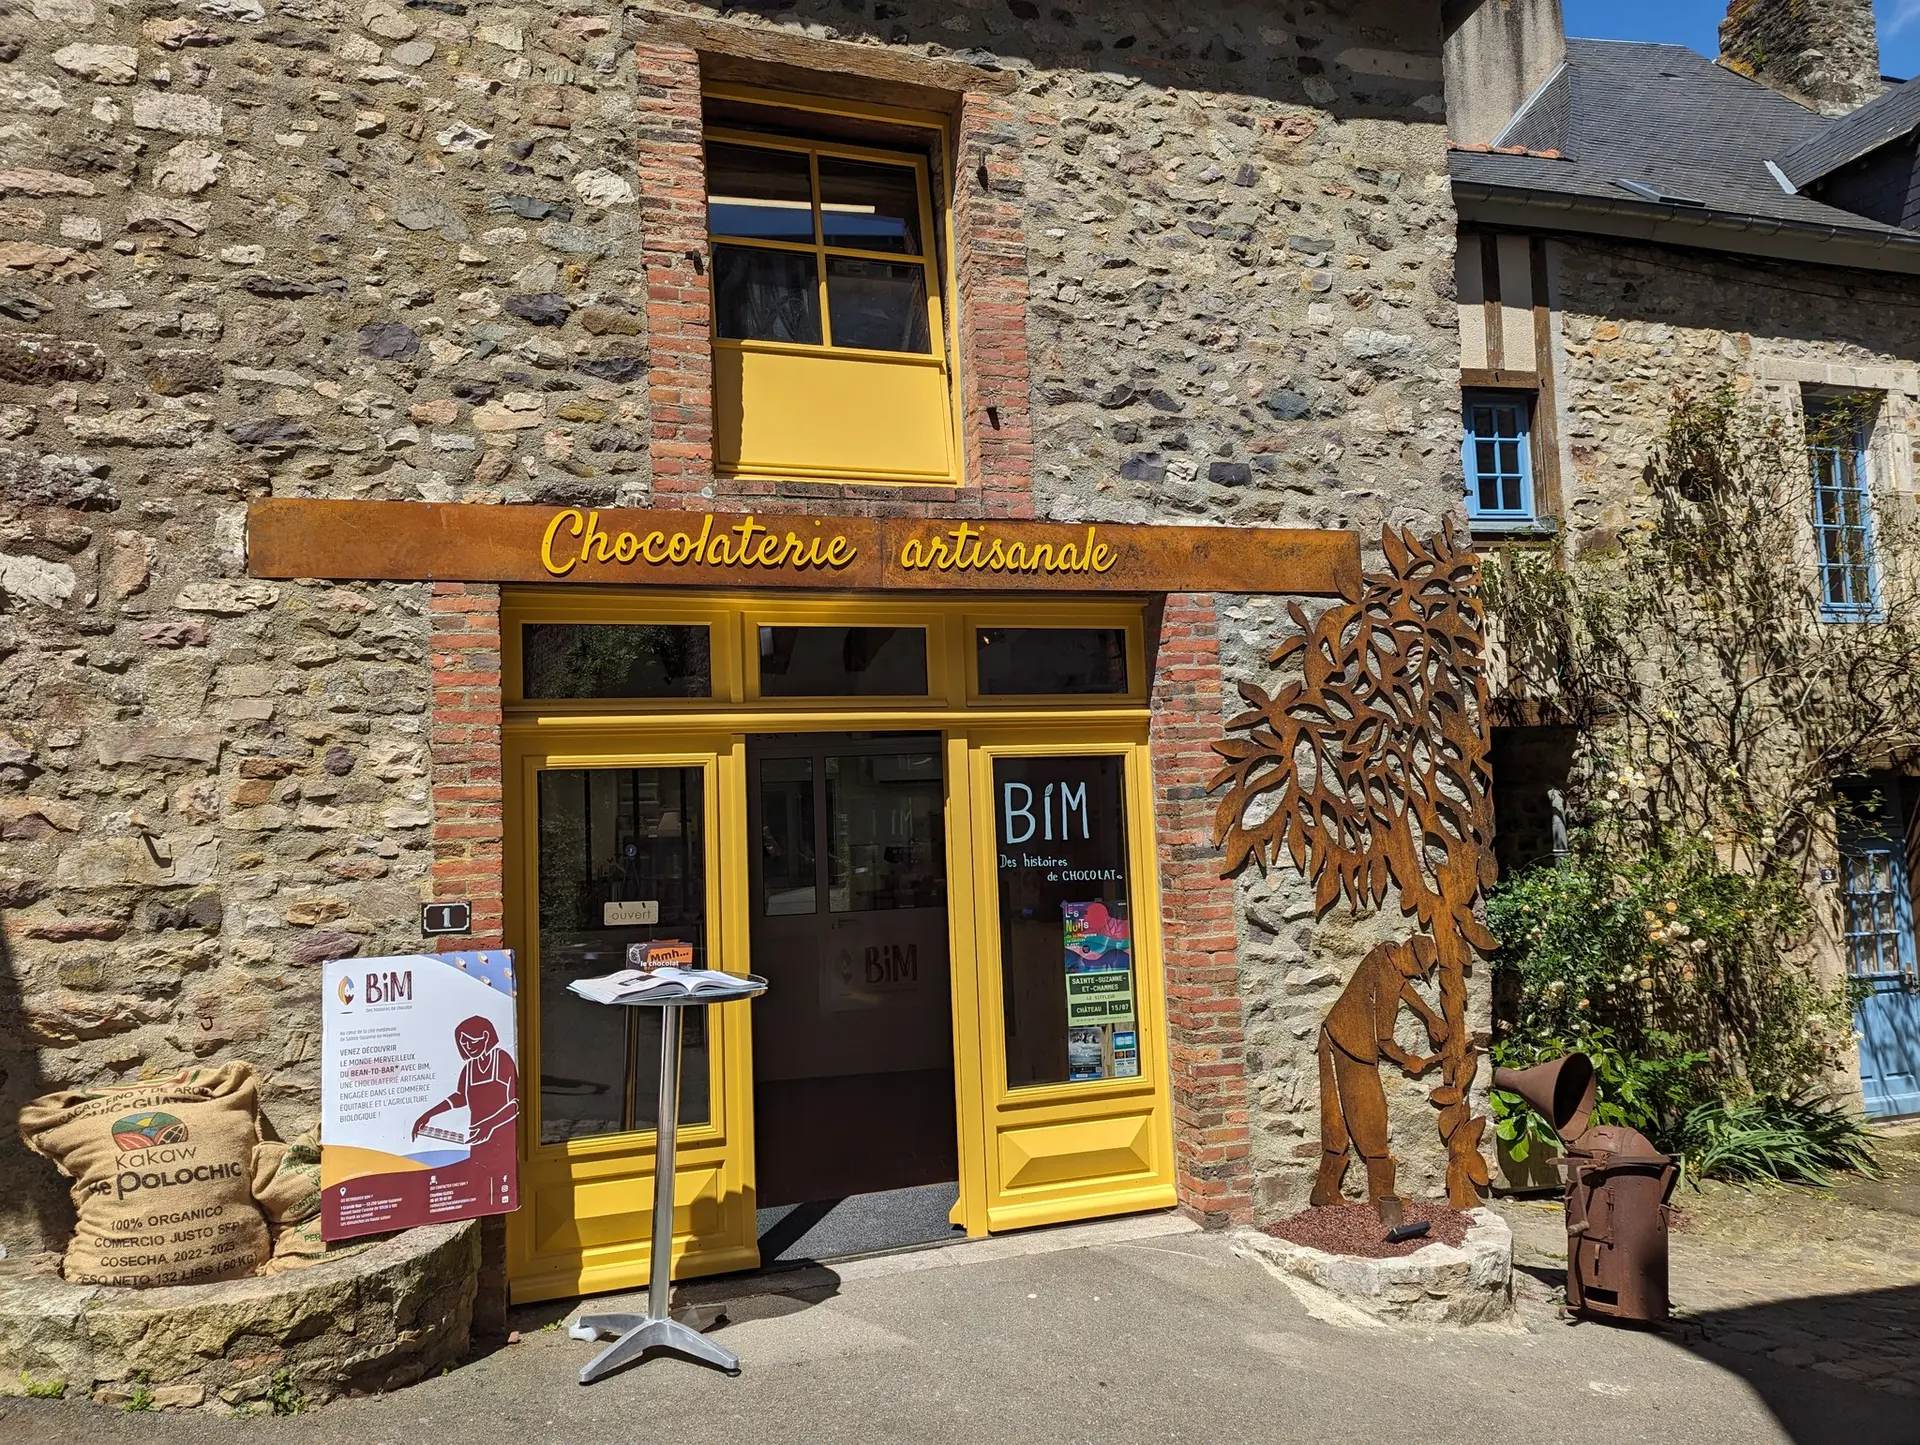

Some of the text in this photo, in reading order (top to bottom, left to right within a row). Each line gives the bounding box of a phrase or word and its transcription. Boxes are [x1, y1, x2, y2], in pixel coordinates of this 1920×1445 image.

[541, 509, 1117, 574] Chocolaterie artisanale
[1000, 852, 1068, 868] Des histoires
[1047, 870, 1116, 881] de CHOCOLAT
[1825, 870, 1832, 880] 3
[442, 908, 452, 928] 1
[612, 910, 651, 920] ouvert
[1072, 975, 1126, 984] SAINTE-SUZANNE-
[340, 1044, 397, 1056] VENEZ DÉCOUVRIR
[349, 1058, 372, 1066] MONDE
[374, 1054, 416, 1064] MERVEILLEUX
[340, 1070, 349, 1078] DU
[400, 1064, 416, 1072] AVEC
[354, 1076, 398, 1088] CHOCOLATERIE
[400, 1072, 436, 1082] ARTISANALE
[340, 1090, 368, 1100] ENGAGÉE
[370, 1088, 386, 1098] DANS
[396, 1084, 430, 1094] COMMERCE
[60, 1102, 102, 1124] CACAO
[106, 1092, 134, 1106] FINO
[340, 1100, 373, 1112] ÉQUITABLE
[340, 1112, 377, 1122] BIOLOGIQUE
[289, 1192, 320, 1214] CONTRA
[110, 1205, 223, 1231] 100% ORGANICO
[94, 1235, 165, 1248] COMERCIO
[170, 1227, 214, 1244] JUSTO
[304, 1234, 320, 1242] PER
[101, 1241, 235, 1268] COSECHA 2022-2023
[112, 1274, 150, 1286] NETO
[156, 1272, 177, 1284] 132
